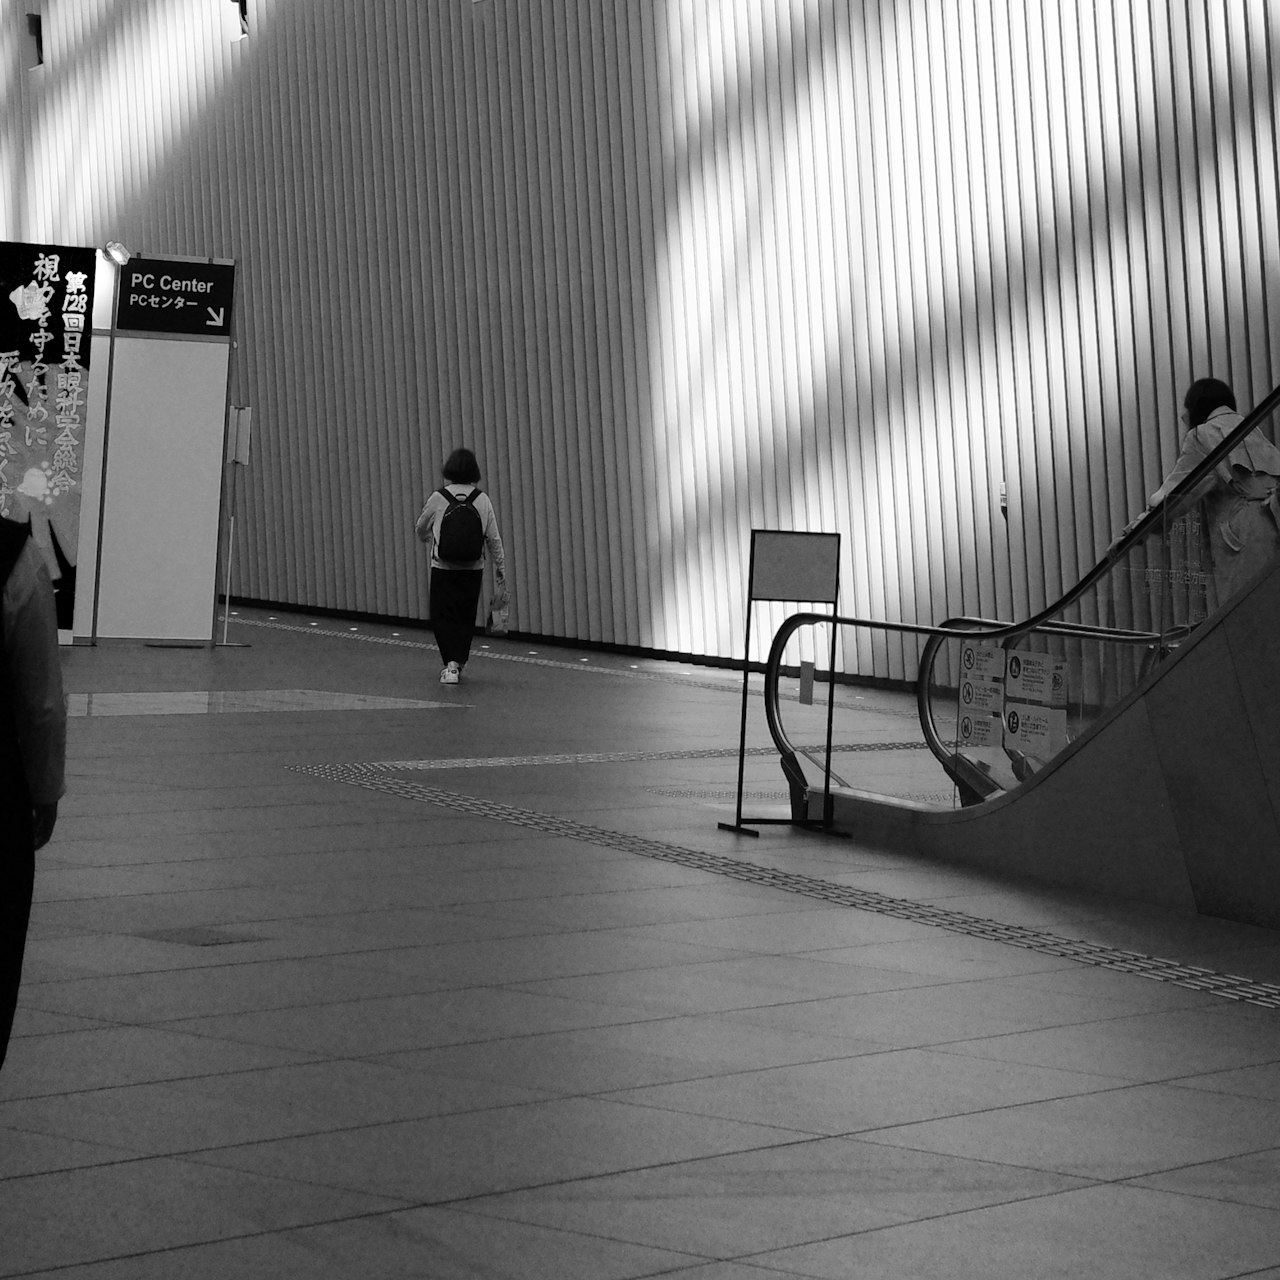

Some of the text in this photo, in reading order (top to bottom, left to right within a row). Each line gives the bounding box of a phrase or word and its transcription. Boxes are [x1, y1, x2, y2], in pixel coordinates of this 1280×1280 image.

[130, 272, 214, 294] PC Center
[129, 293, 199, 310] PCセンター
[52, 271, 89, 494] 第128回日本眼科学会総会
